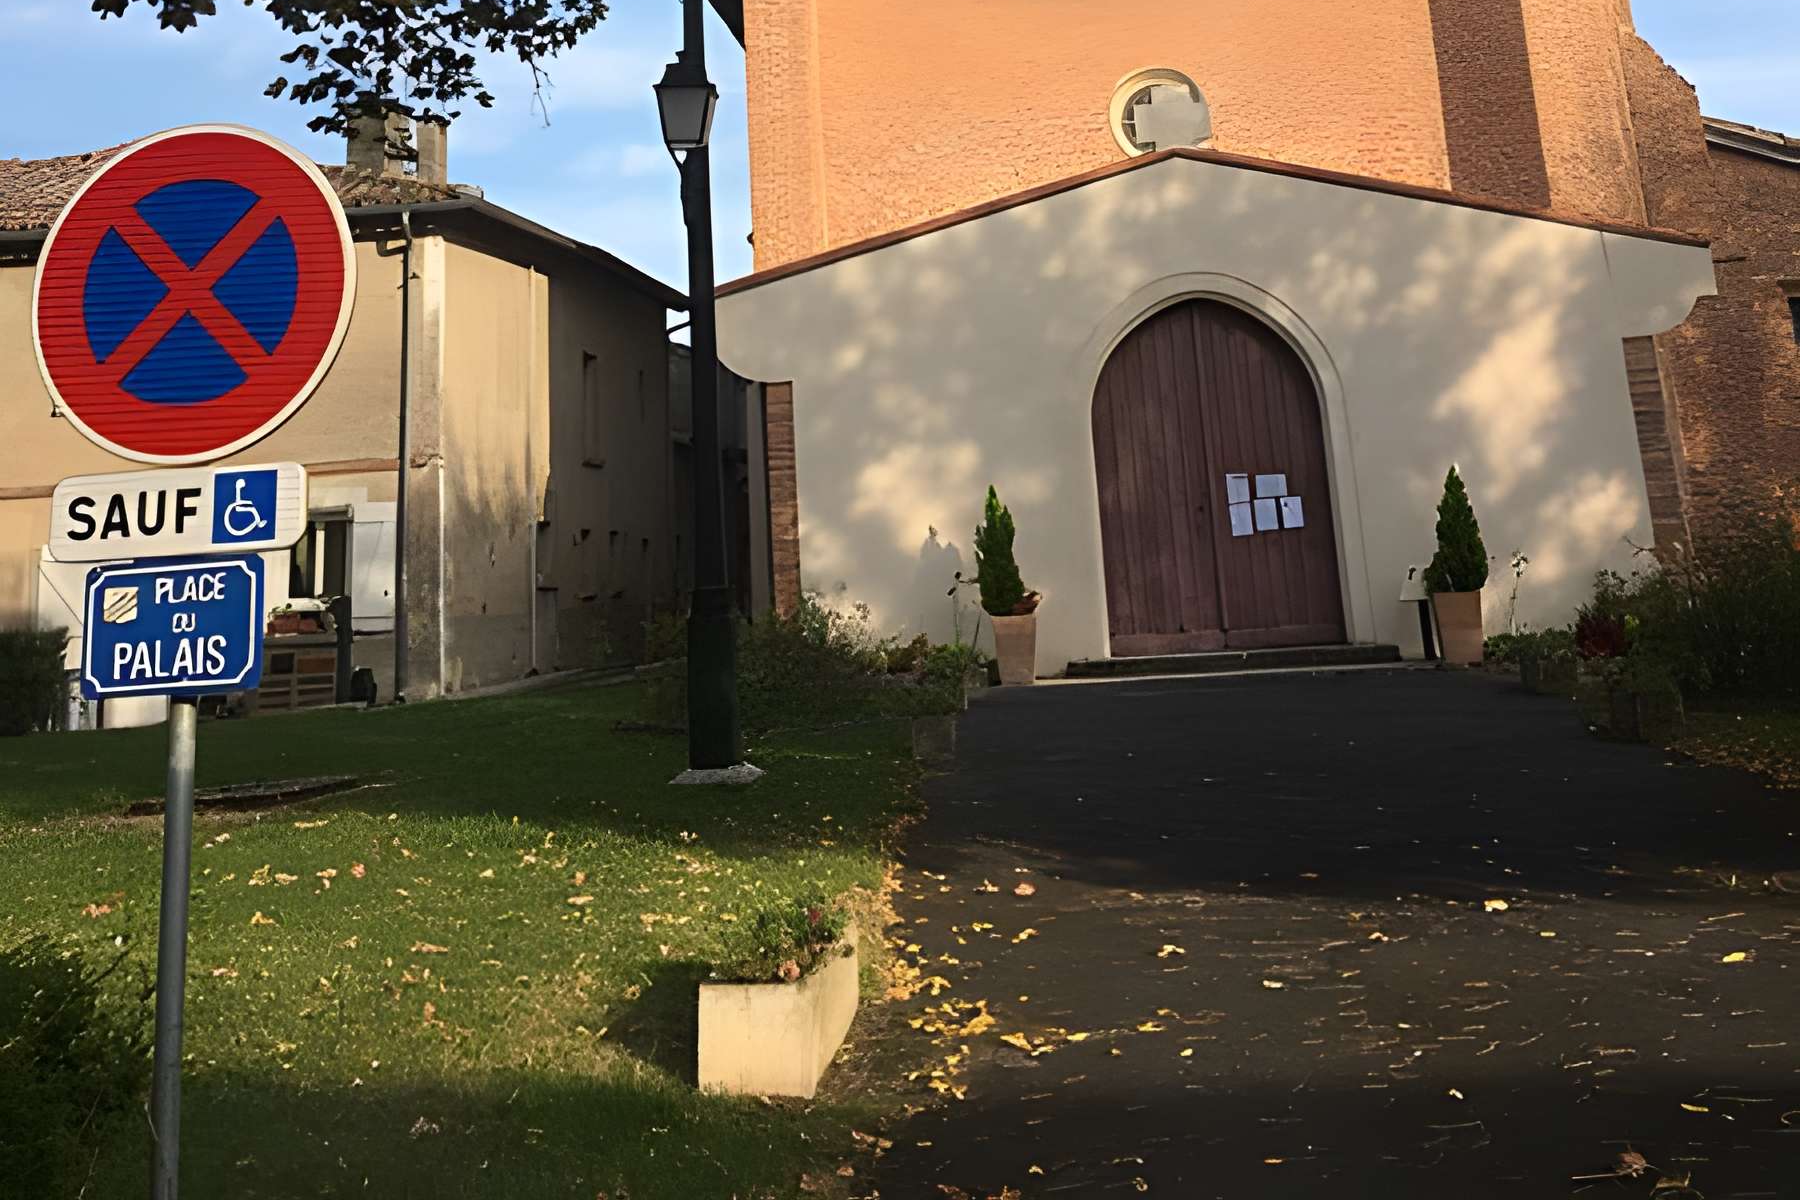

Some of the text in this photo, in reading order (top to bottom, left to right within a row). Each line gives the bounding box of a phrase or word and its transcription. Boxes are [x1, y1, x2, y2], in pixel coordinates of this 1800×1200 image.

[67, 488, 201, 540] SAUF
[155, 572, 227, 604] PLACE
[113, 634, 227, 680] PALAIS
